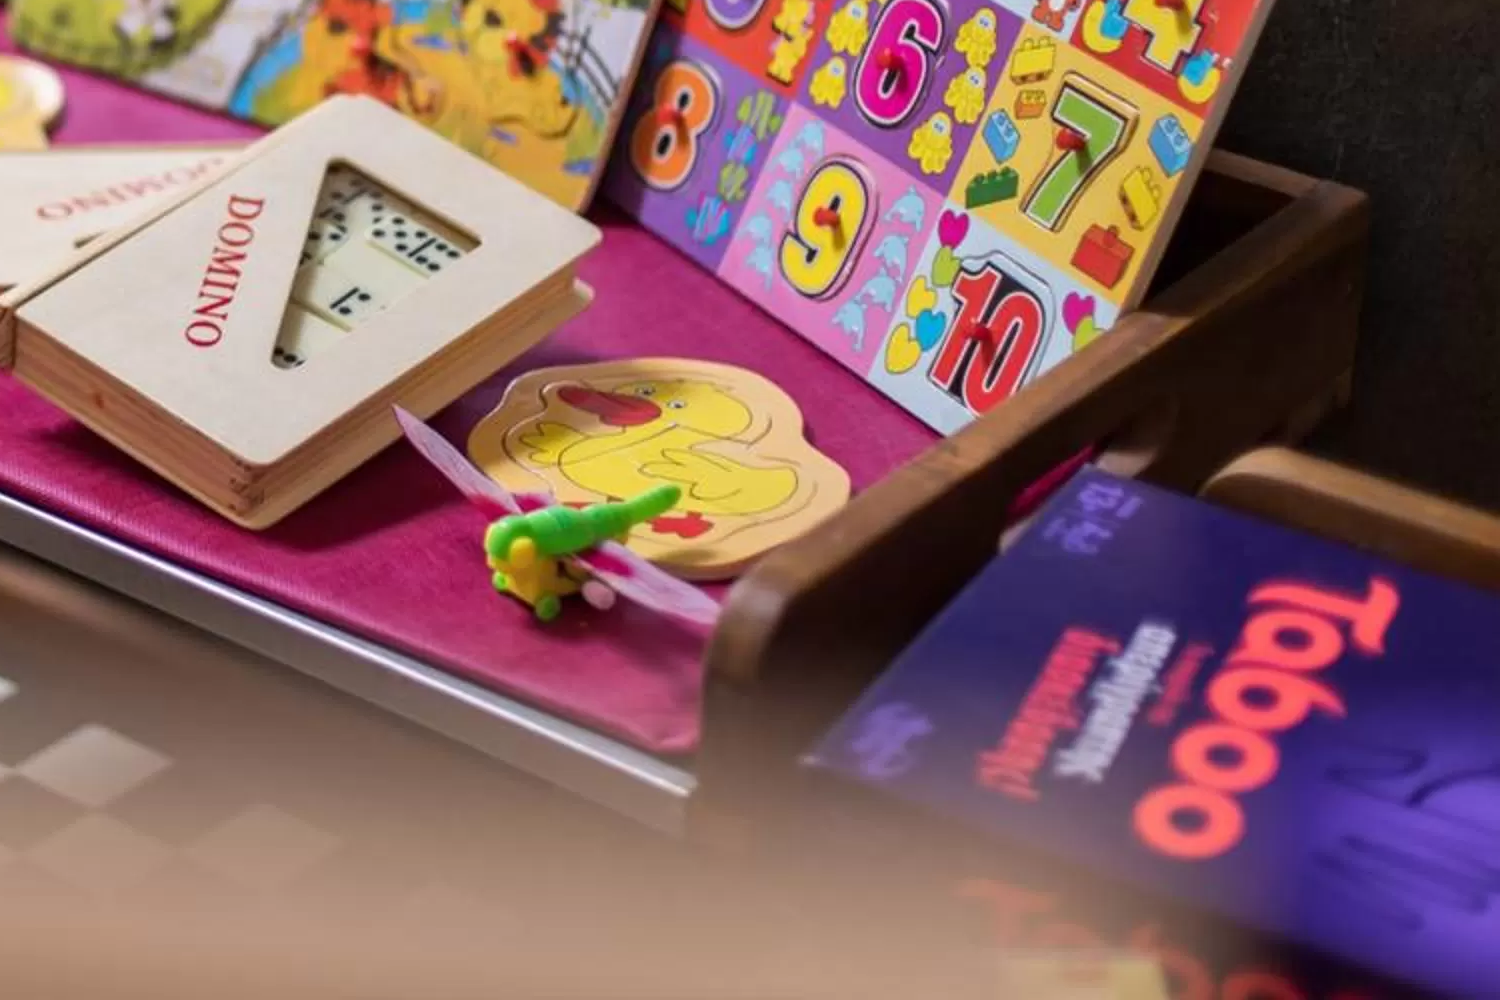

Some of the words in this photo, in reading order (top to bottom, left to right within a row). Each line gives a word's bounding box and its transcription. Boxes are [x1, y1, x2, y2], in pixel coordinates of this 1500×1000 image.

[630, 59, 716, 190] 8
[1021, 78, 1132, 233] 7
[183, 194, 264, 349] DOMINO
[778, 158, 870, 298] 9
[927, 257, 1046, 417] 10
[1133, 576, 1400, 860] Taboo
